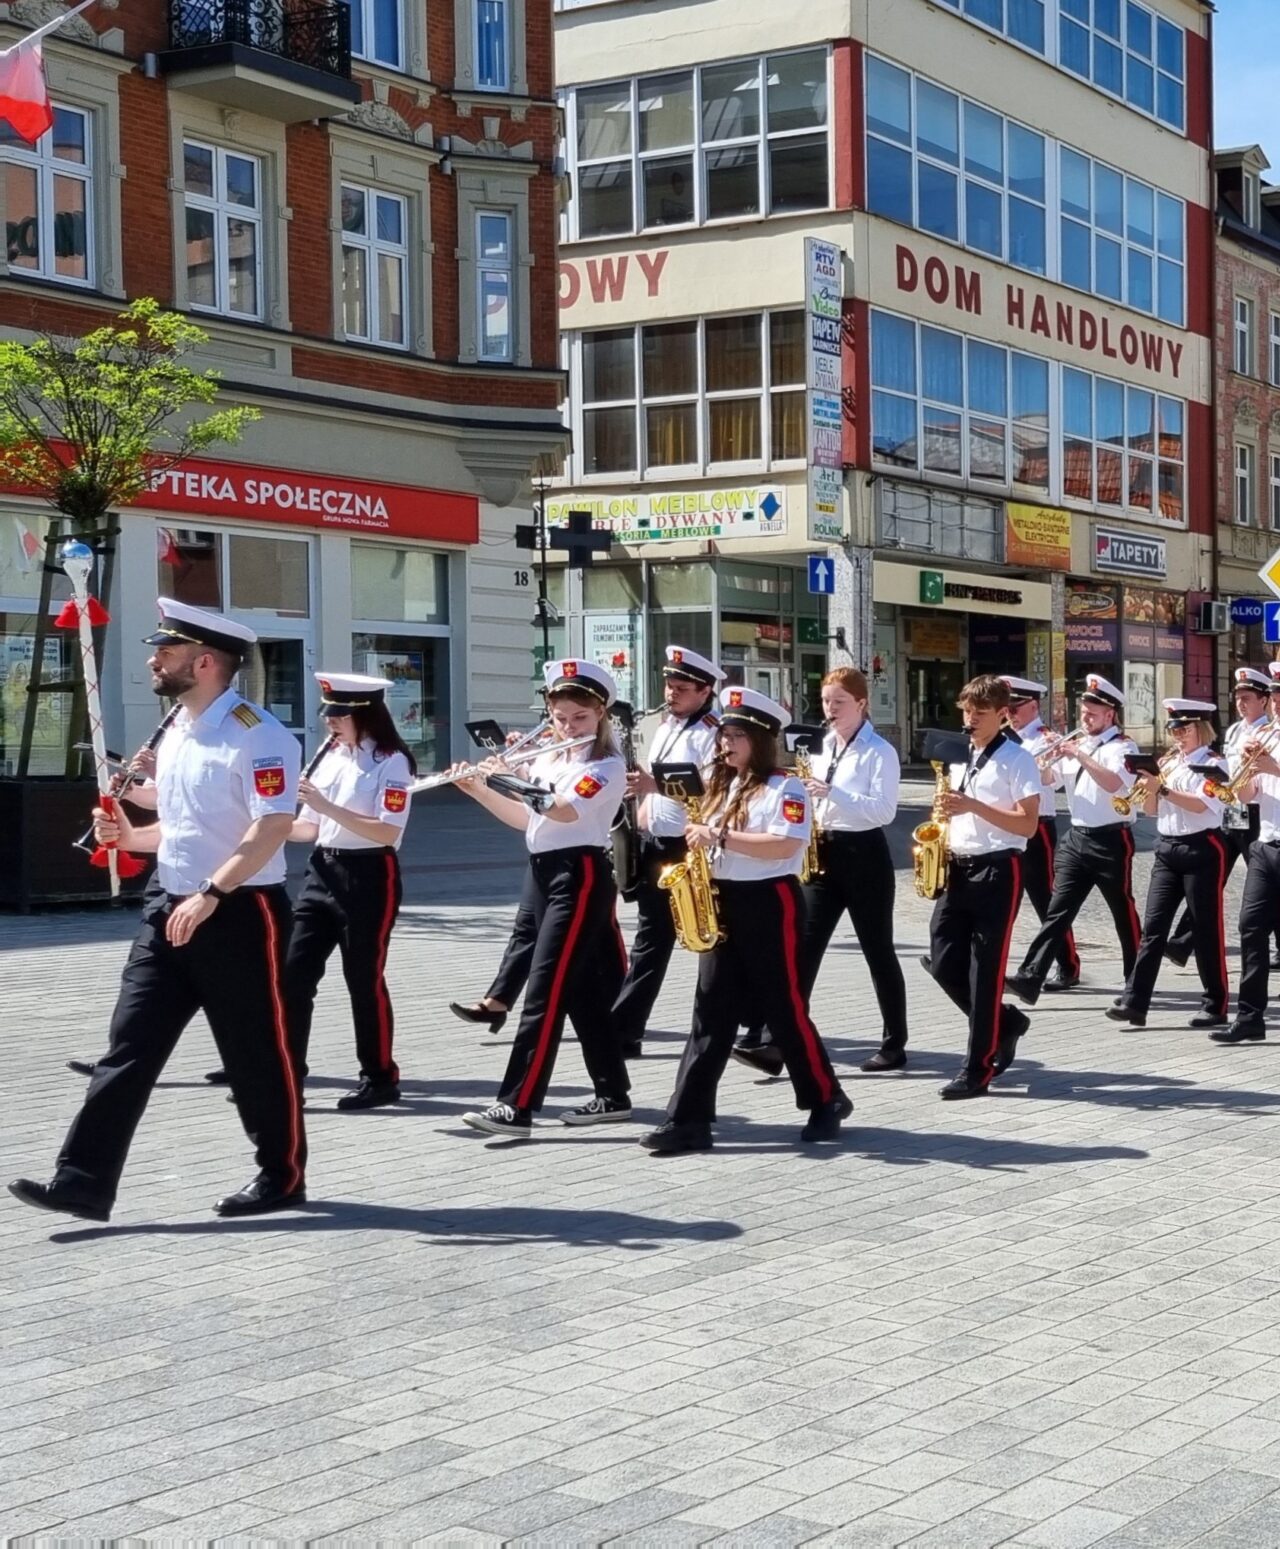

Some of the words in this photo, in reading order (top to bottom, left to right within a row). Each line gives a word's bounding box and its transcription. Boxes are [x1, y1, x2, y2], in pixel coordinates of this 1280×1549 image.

[815, 252, 835, 266] RTV
[816, 264, 836, 277] AGD
[895, 244, 982, 316] DOM
[1006, 284, 1184, 379] HANDLOWY
[244, 480, 389, 519] SPOŁECZNA
[650, 490, 758, 515] MEBLOWY
[656, 511, 738, 529] DYWANY
[660, 526, 716, 539] MEBLOWE
[814, 524, 842, 537] ROLNIK
[1112, 541, 1158, 565] TAPETY
[514, 571, 529, 587] 18
[1230, 605, 1262, 617] ALKO
